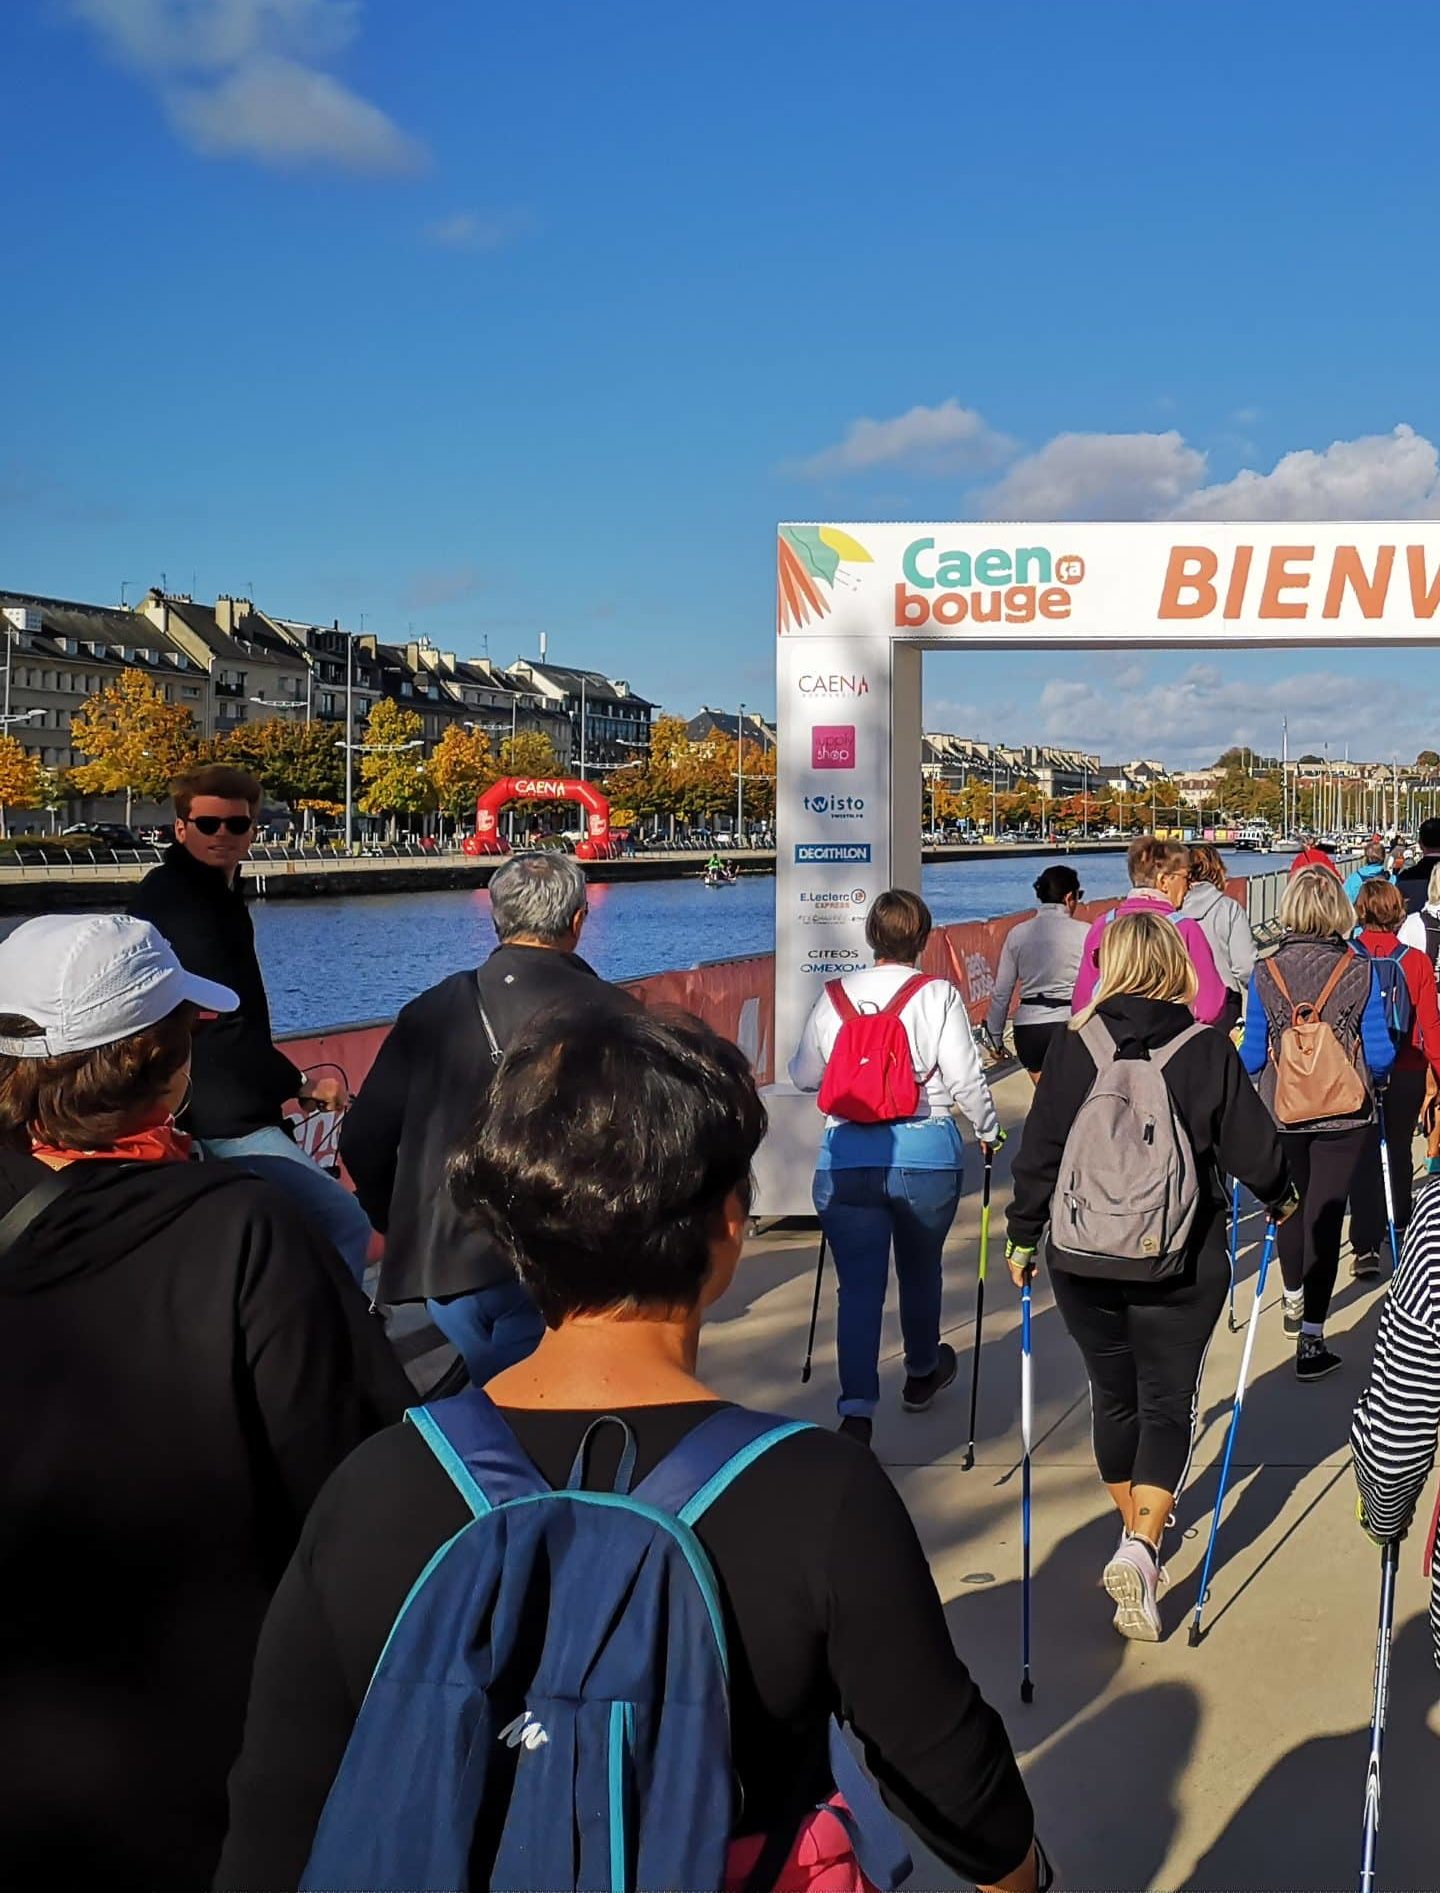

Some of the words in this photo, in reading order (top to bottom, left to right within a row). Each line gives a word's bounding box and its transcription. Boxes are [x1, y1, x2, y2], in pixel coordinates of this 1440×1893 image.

[902, 537, 1052, 589] Caen
[893, 582, 1072, 628] bouge
[798, 674, 857, 694] CAEN
[816, 746, 850, 761] shop
[514, 780, 557, 794] CAEN
[803, 794, 865, 814] twisto
[798, 847, 867, 860] DECATHLON
[800, 891, 850, 902] E.Leclerc
[808, 949, 859, 959] CITEOS
